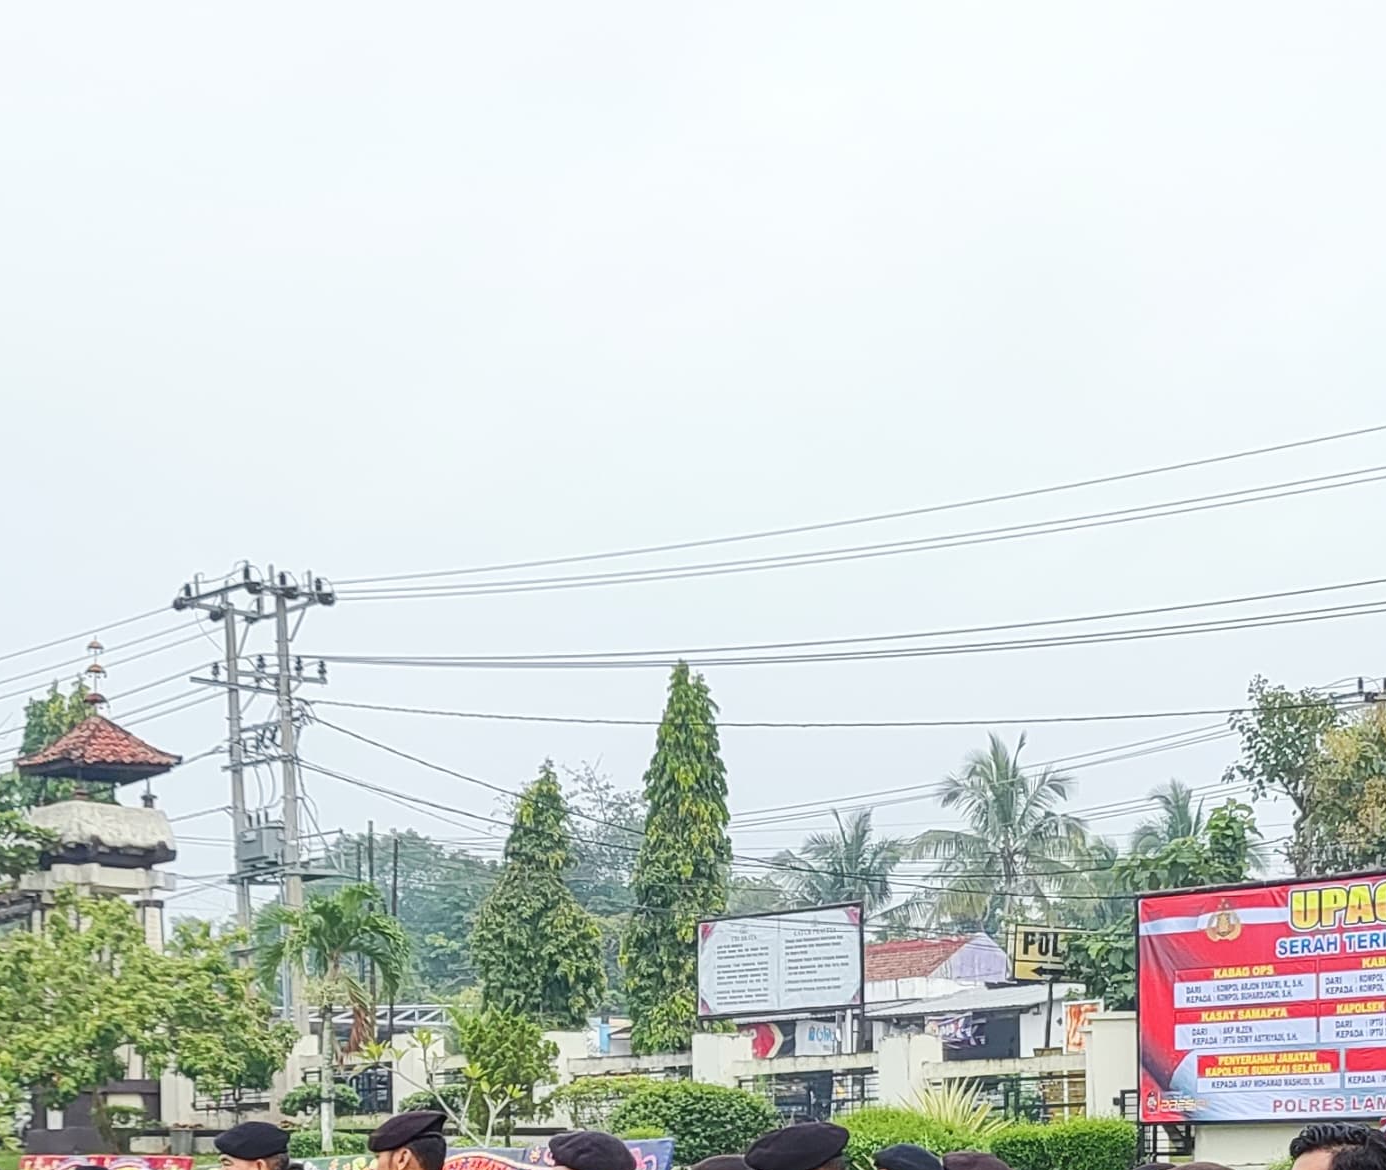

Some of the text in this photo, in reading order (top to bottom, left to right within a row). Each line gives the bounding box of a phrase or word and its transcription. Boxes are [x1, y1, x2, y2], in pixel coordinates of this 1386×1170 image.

[1023, 931, 1063, 957] POL
[1278, 937, 1338, 956] SERAH
[1214, 964, 1274, 979] KABAG OPS
[1325, 976, 1342, 985] DARI
[1326, 985, 1353, 995] KEPADA
[1336, 1001, 1385, 1014] KAPOLSEK
[1201, 1008, 1288, 1022] KASAT SAMAPTA
[1335, 1020, 1353, 1029] DARI
[1335, 1028, 1364, 1038] KEPADA
[1218, 1051, 1317, 1066] PENYERAHAN JABATAN
[1205, 1065, 1249, 1077] KAPOLSEK
[1292, 1062, 1331, 1074] SELATAN
[1348, 1075, 1376, 1084] KEPADA
[1273, 1097, 1345, 1113] POLRES
